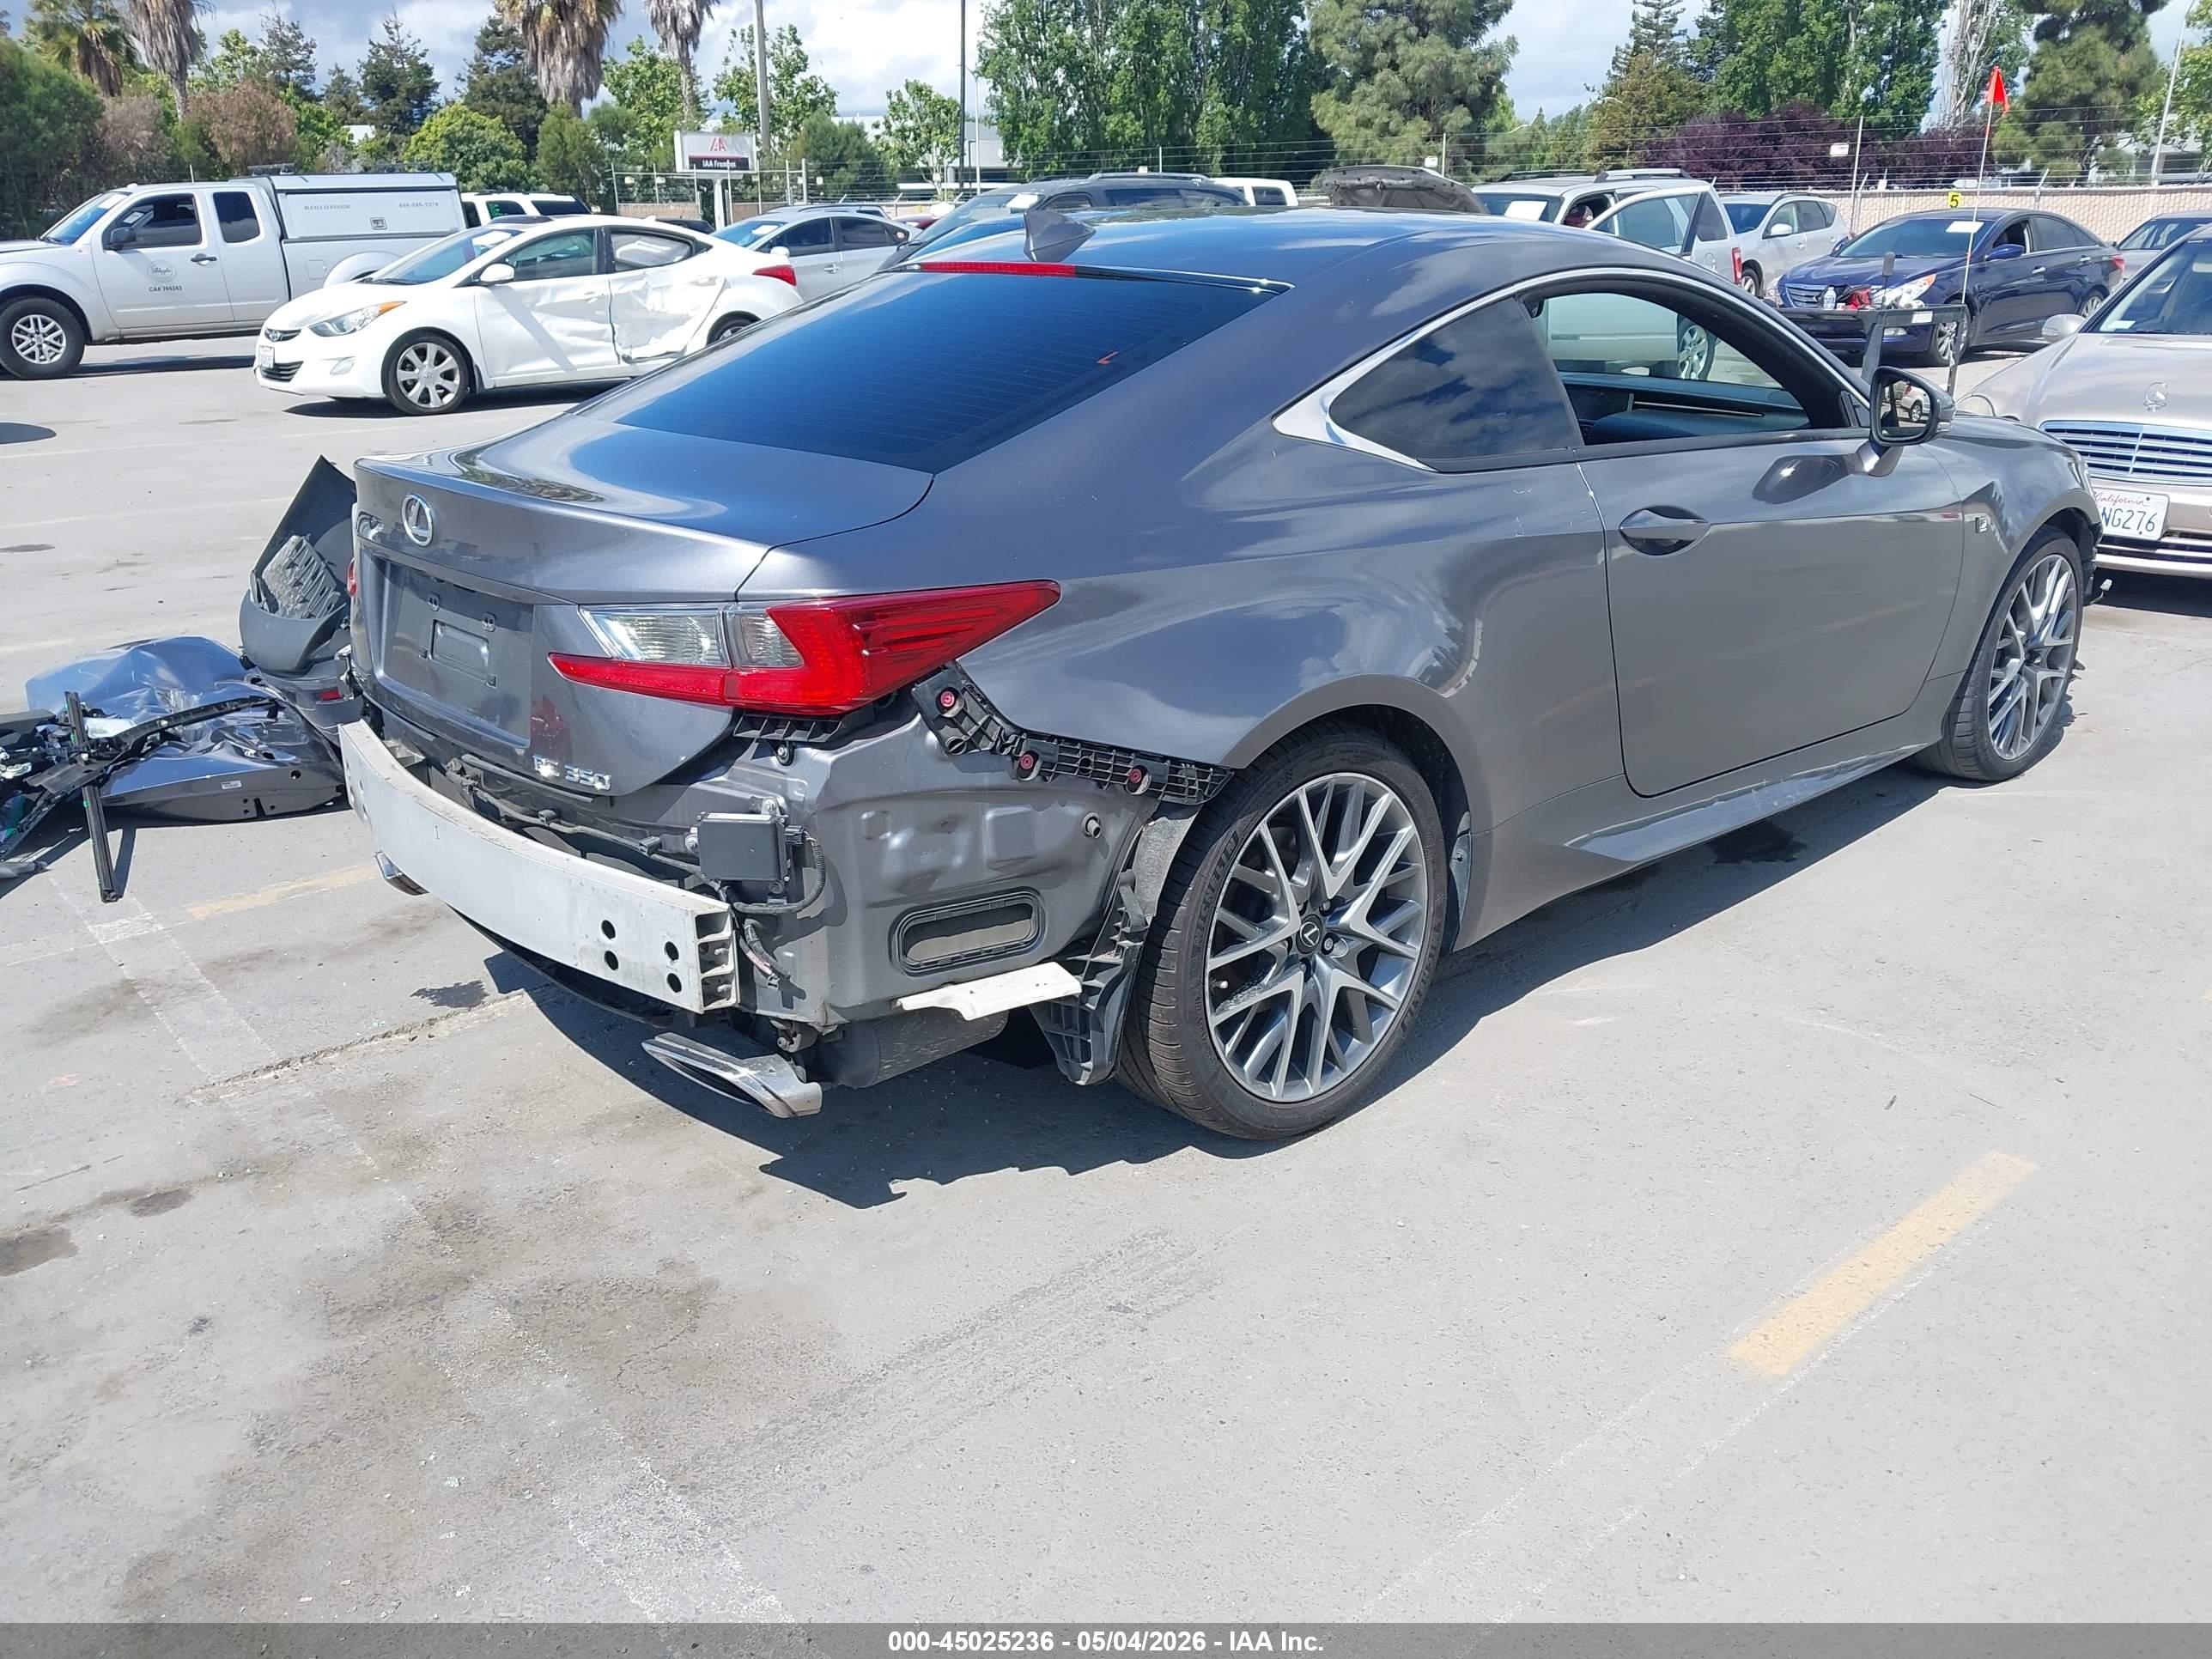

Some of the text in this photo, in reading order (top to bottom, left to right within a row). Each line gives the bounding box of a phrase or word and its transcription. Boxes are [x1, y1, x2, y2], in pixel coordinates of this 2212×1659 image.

[1949, 194, 1960, 207] 5
[2094, 491, 2146, 507] California
[564, 764, 612, 791] 350
[1193, 831, 1239, 947] MICHELIN
